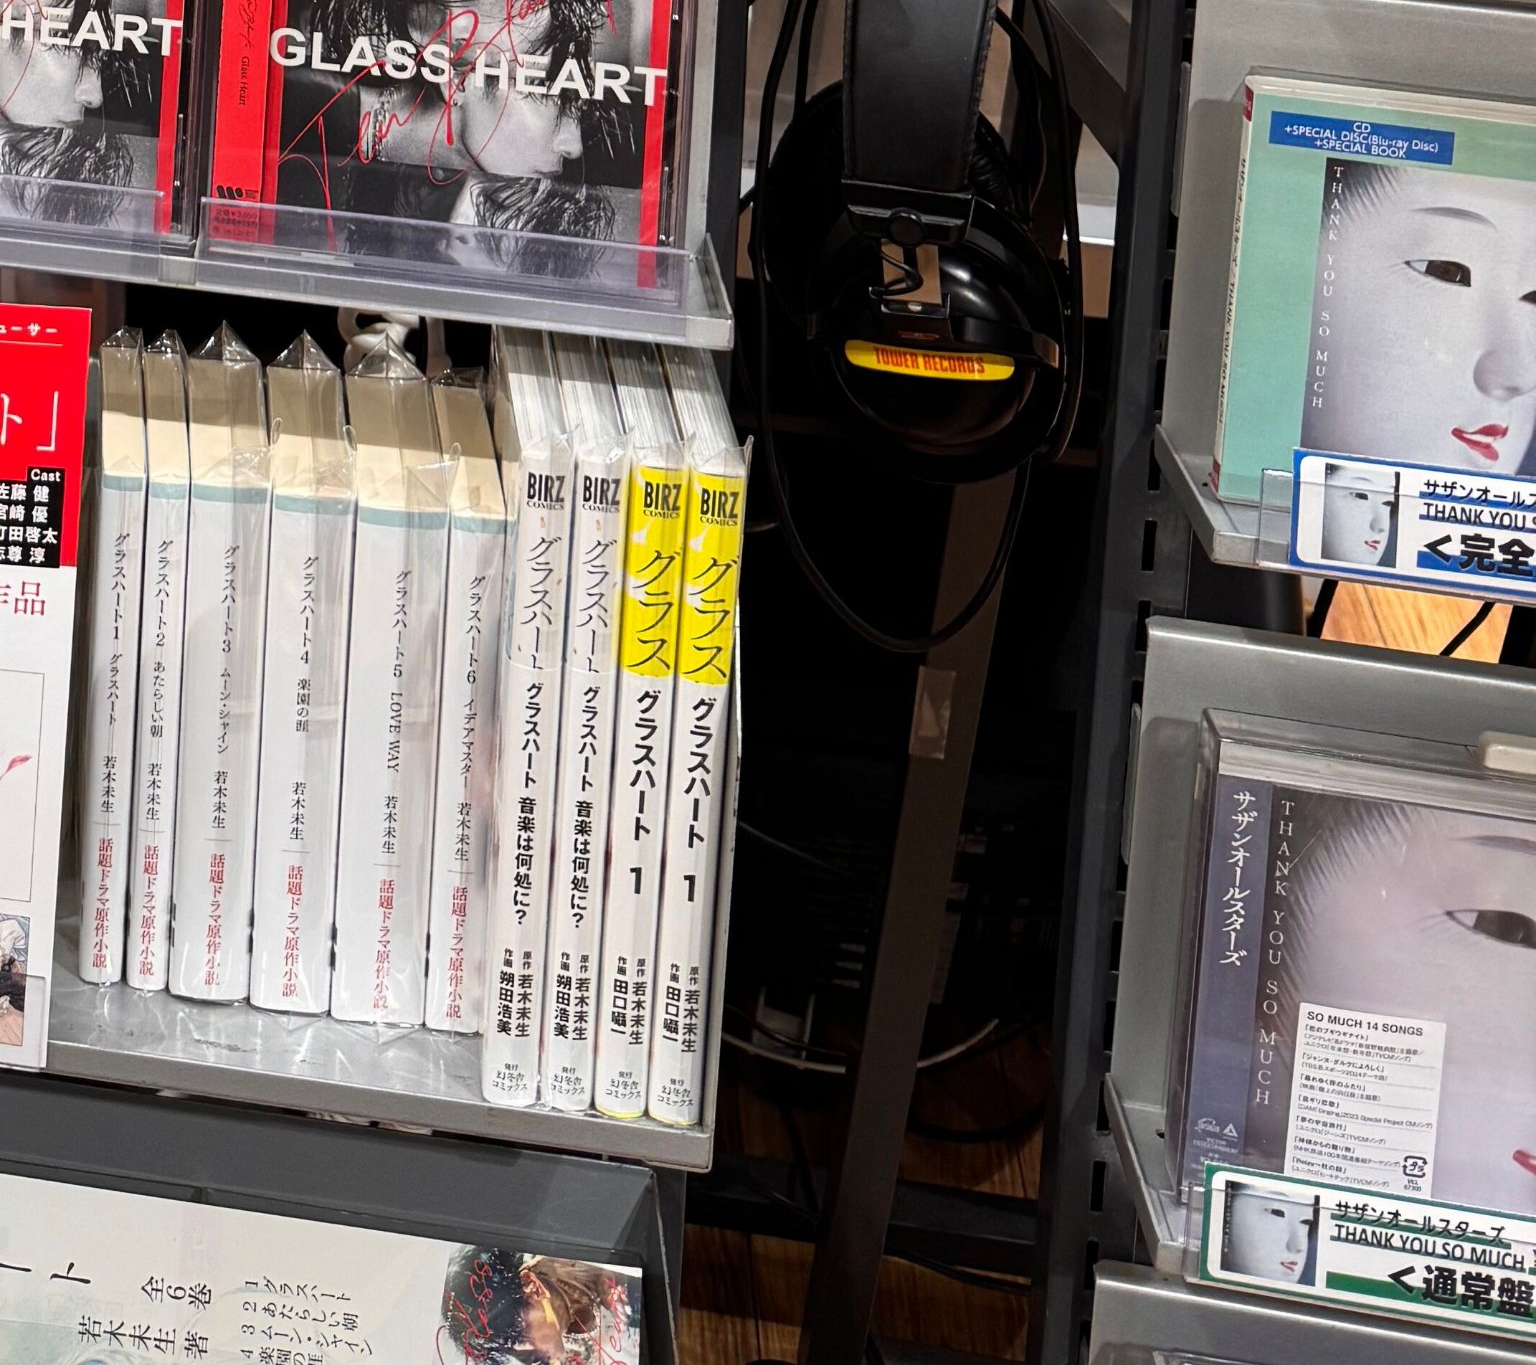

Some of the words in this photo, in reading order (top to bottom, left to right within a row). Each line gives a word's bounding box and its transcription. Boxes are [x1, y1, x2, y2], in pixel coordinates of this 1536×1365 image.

[2, 5, 184, 57] HEART
[270, 27, 455, 84] GLASS
[475, 54, 668, 107] HEART
[1353, 122, 1371, 133] CD
[1328, 166, 1344, 242] THANK
[1323, 254, 1335, 298] YOU
[1318, 310, 1331, 337] SO
[874, 347, 919, 369] TOWER
[923, 353, 985, 374] RECORDS
[1311, 349, 1328, 409] MUCH
[31, 469, 61, 482] Cast
[526, 471, 565, 503] BIRZ
[582, 474, 621, 506] BIRZ
[1423, 503, 1484, 525] THANK
[1489, 510, 1526, 529] YOU
[111, 532, 129, 643] グラスハート1
[154, 539, 174, 647] グラスハート2
[520, 536, 562, 670] グラスハート
[634, 550, 681, 670] グラス
[519, 681, 544, 786] グラスハート
[100, 755, 118, 813] 若木未生
[145, 762, 163, 822] 若木未生
[628, 689, 662, 842] グラスハート
[512, 796, 537, 926] 音楽は何処に？
[1274, 800, 1295, 897] THANK
[91, 837, 114, 969] 話題ドラマ原作小説
[629, 866, 642, 895] 1
[1219, 790, 1258, 967] サザンオールスターズ
[138, 844, 160, 976] 話題ドラマ原作小説
[523, 951, 532, 970] 原作
[1266, 911, 1284, 966] YOU
[637, 959, 646, 977] 原作
[515, 974, 533, 1038] 若木未生
[629, 981, 647, 1045] 若木未生
[1262, 979, 1278, 1016] SO
[1307, 1011, 1324, 1022] SO
[1328, 1015, 1362, 1029] MUCH
[1366, 1021, 1379, 1031] 14
[1382, 1023, 1423, 1037] SONGS
[1254, 1028, 1276, 1106] MUCH
[1334, 1223, 1396, 1249] THANK
[1400, 1234, 1436, 1256] YOU
[1442, 1242, 1464, 1260] SO
[1471, 1247, 1526, 1270] MUCH
[1335, 1200, 1505, 1246] サザンオールスターズ
[141, 1276, 213, 1309] 全6巻
[79, 1314, 176, 1357] 若木未生
[185, 1336, 210, 1360] 著
